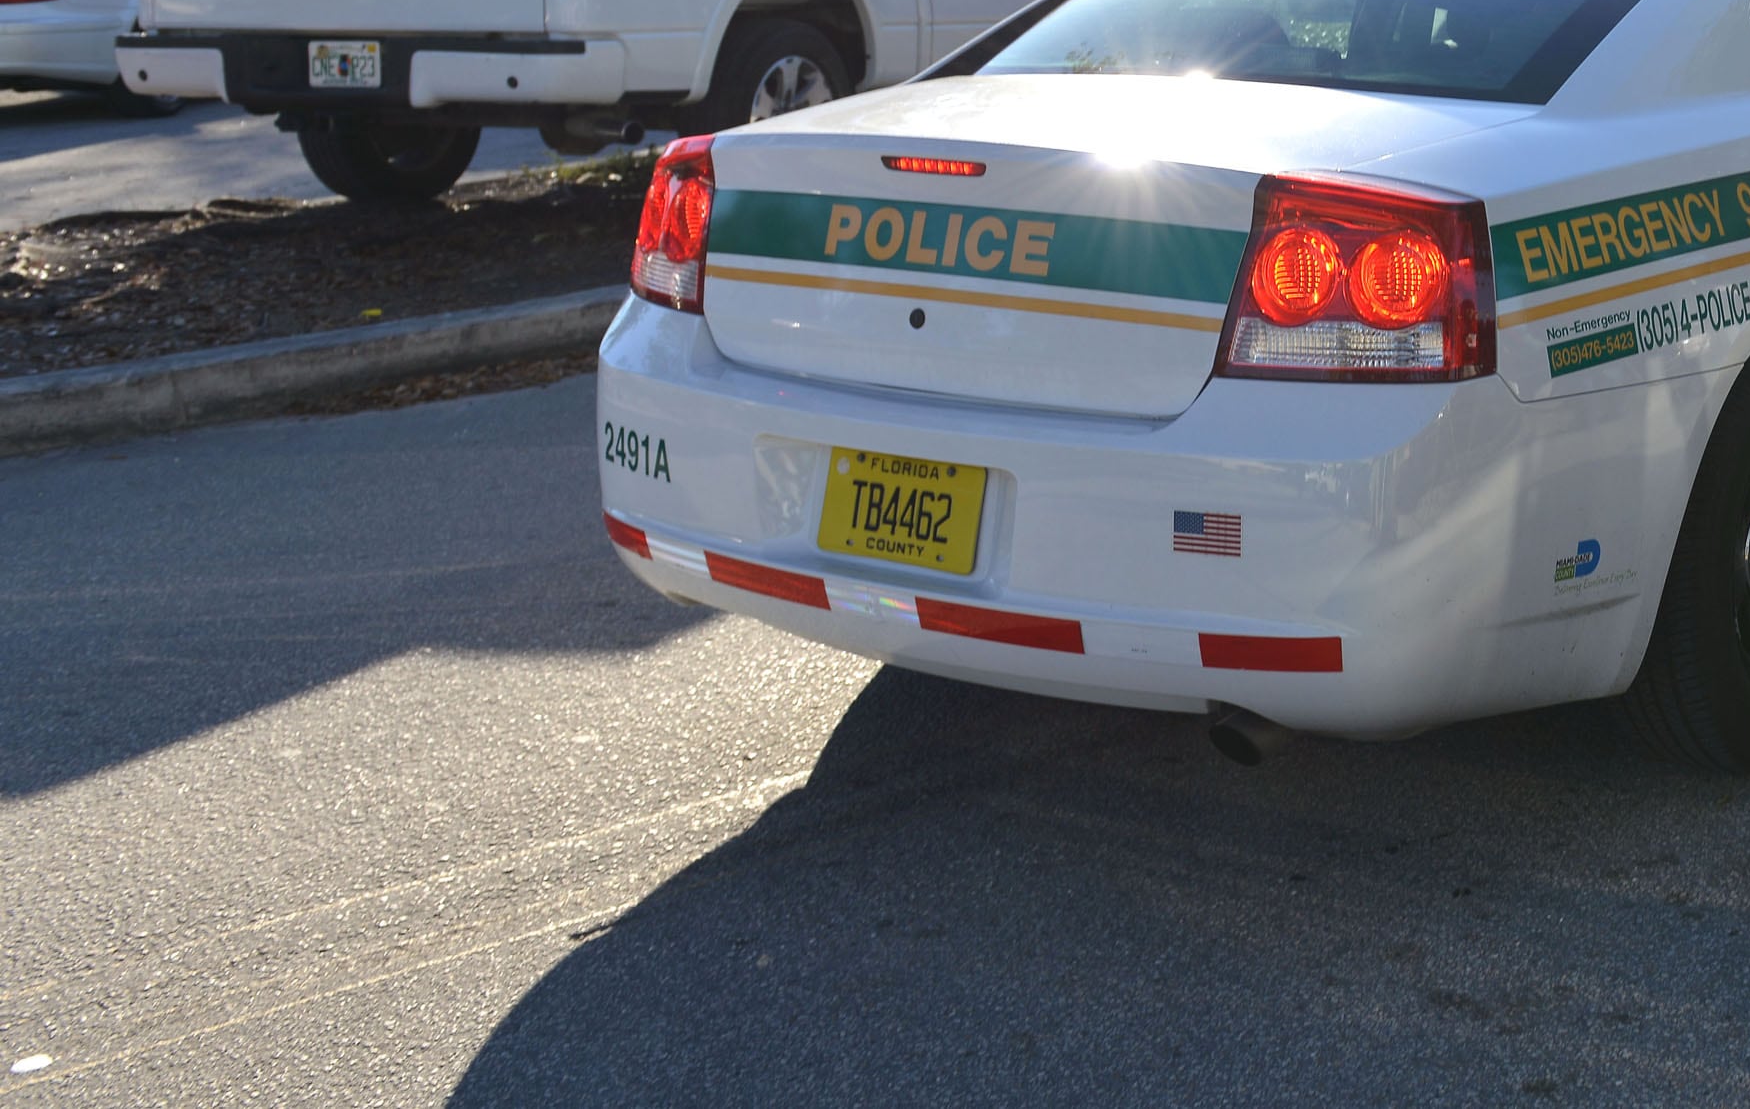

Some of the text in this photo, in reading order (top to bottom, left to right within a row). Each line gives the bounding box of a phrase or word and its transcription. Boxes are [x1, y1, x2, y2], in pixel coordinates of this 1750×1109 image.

[824, 203, 1056, 277] POLICE
[1515, 189, 1725, 283] EMERGENCY
[1547, 310, 1630, 340] Non-Emergency
[1550, 330, 1635, 371] (305)476-5423
[605, 421, 671, 483] 2491A
[871, 457, 939, 481] FLORIDA
[851, 479, 953, 544] TB4462
[866, 537, 925, 557] COUNTY
